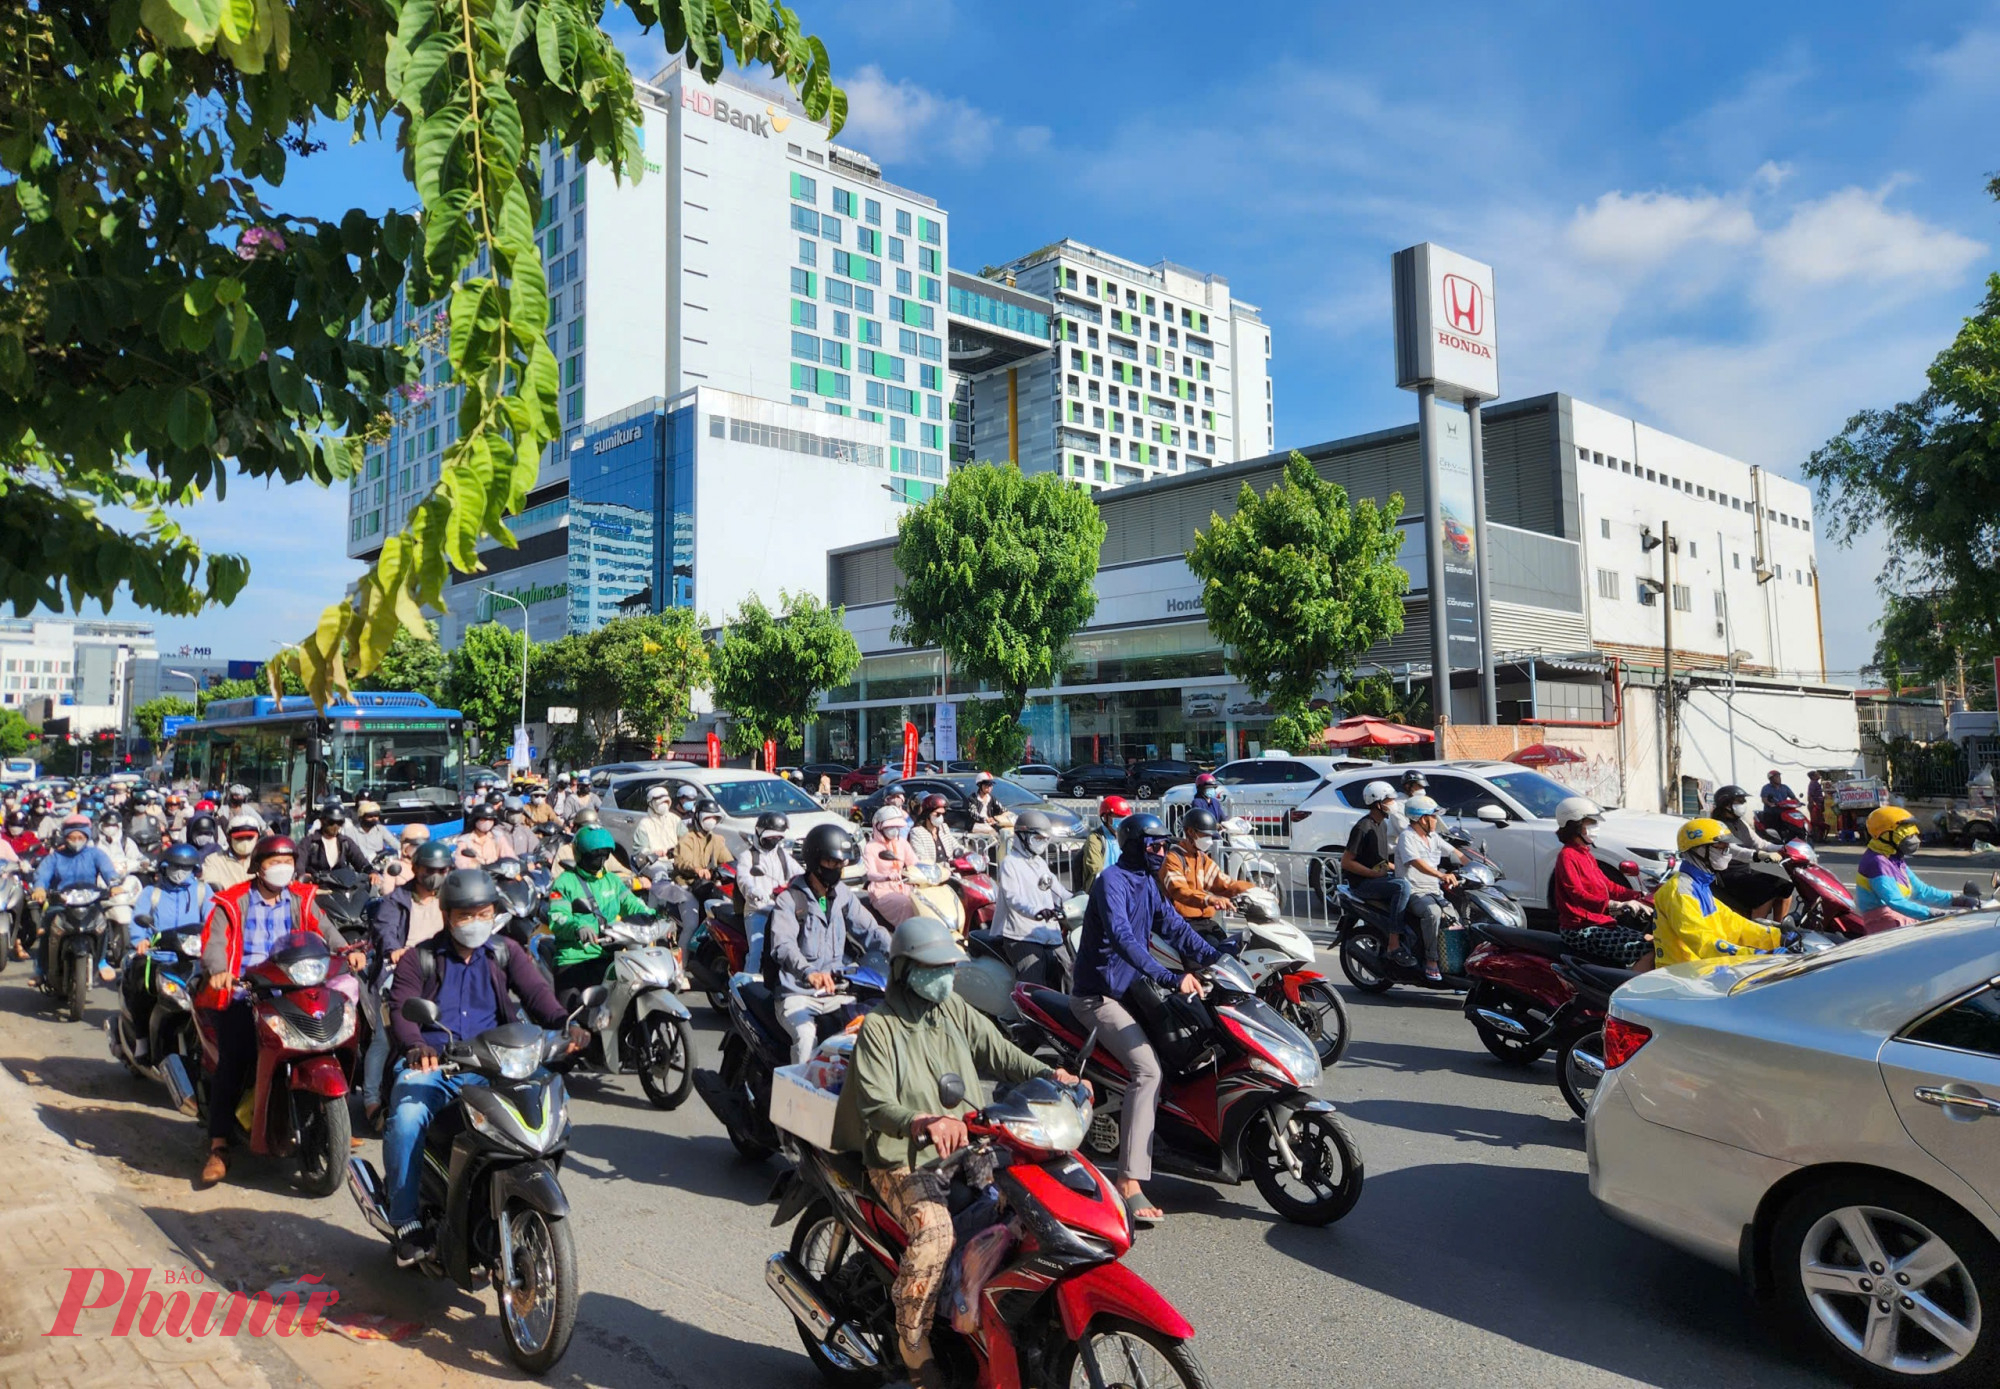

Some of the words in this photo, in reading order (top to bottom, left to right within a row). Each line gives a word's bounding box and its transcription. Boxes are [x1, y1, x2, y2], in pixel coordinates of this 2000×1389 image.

[681, 86, 769, 139] HDBank
[1438, 332, 1491, 359] HONDA
[593, 426, 642, 455] sumikura
[194, 647, 211, 655] MB
[1686, 829, 1703, 840] be
